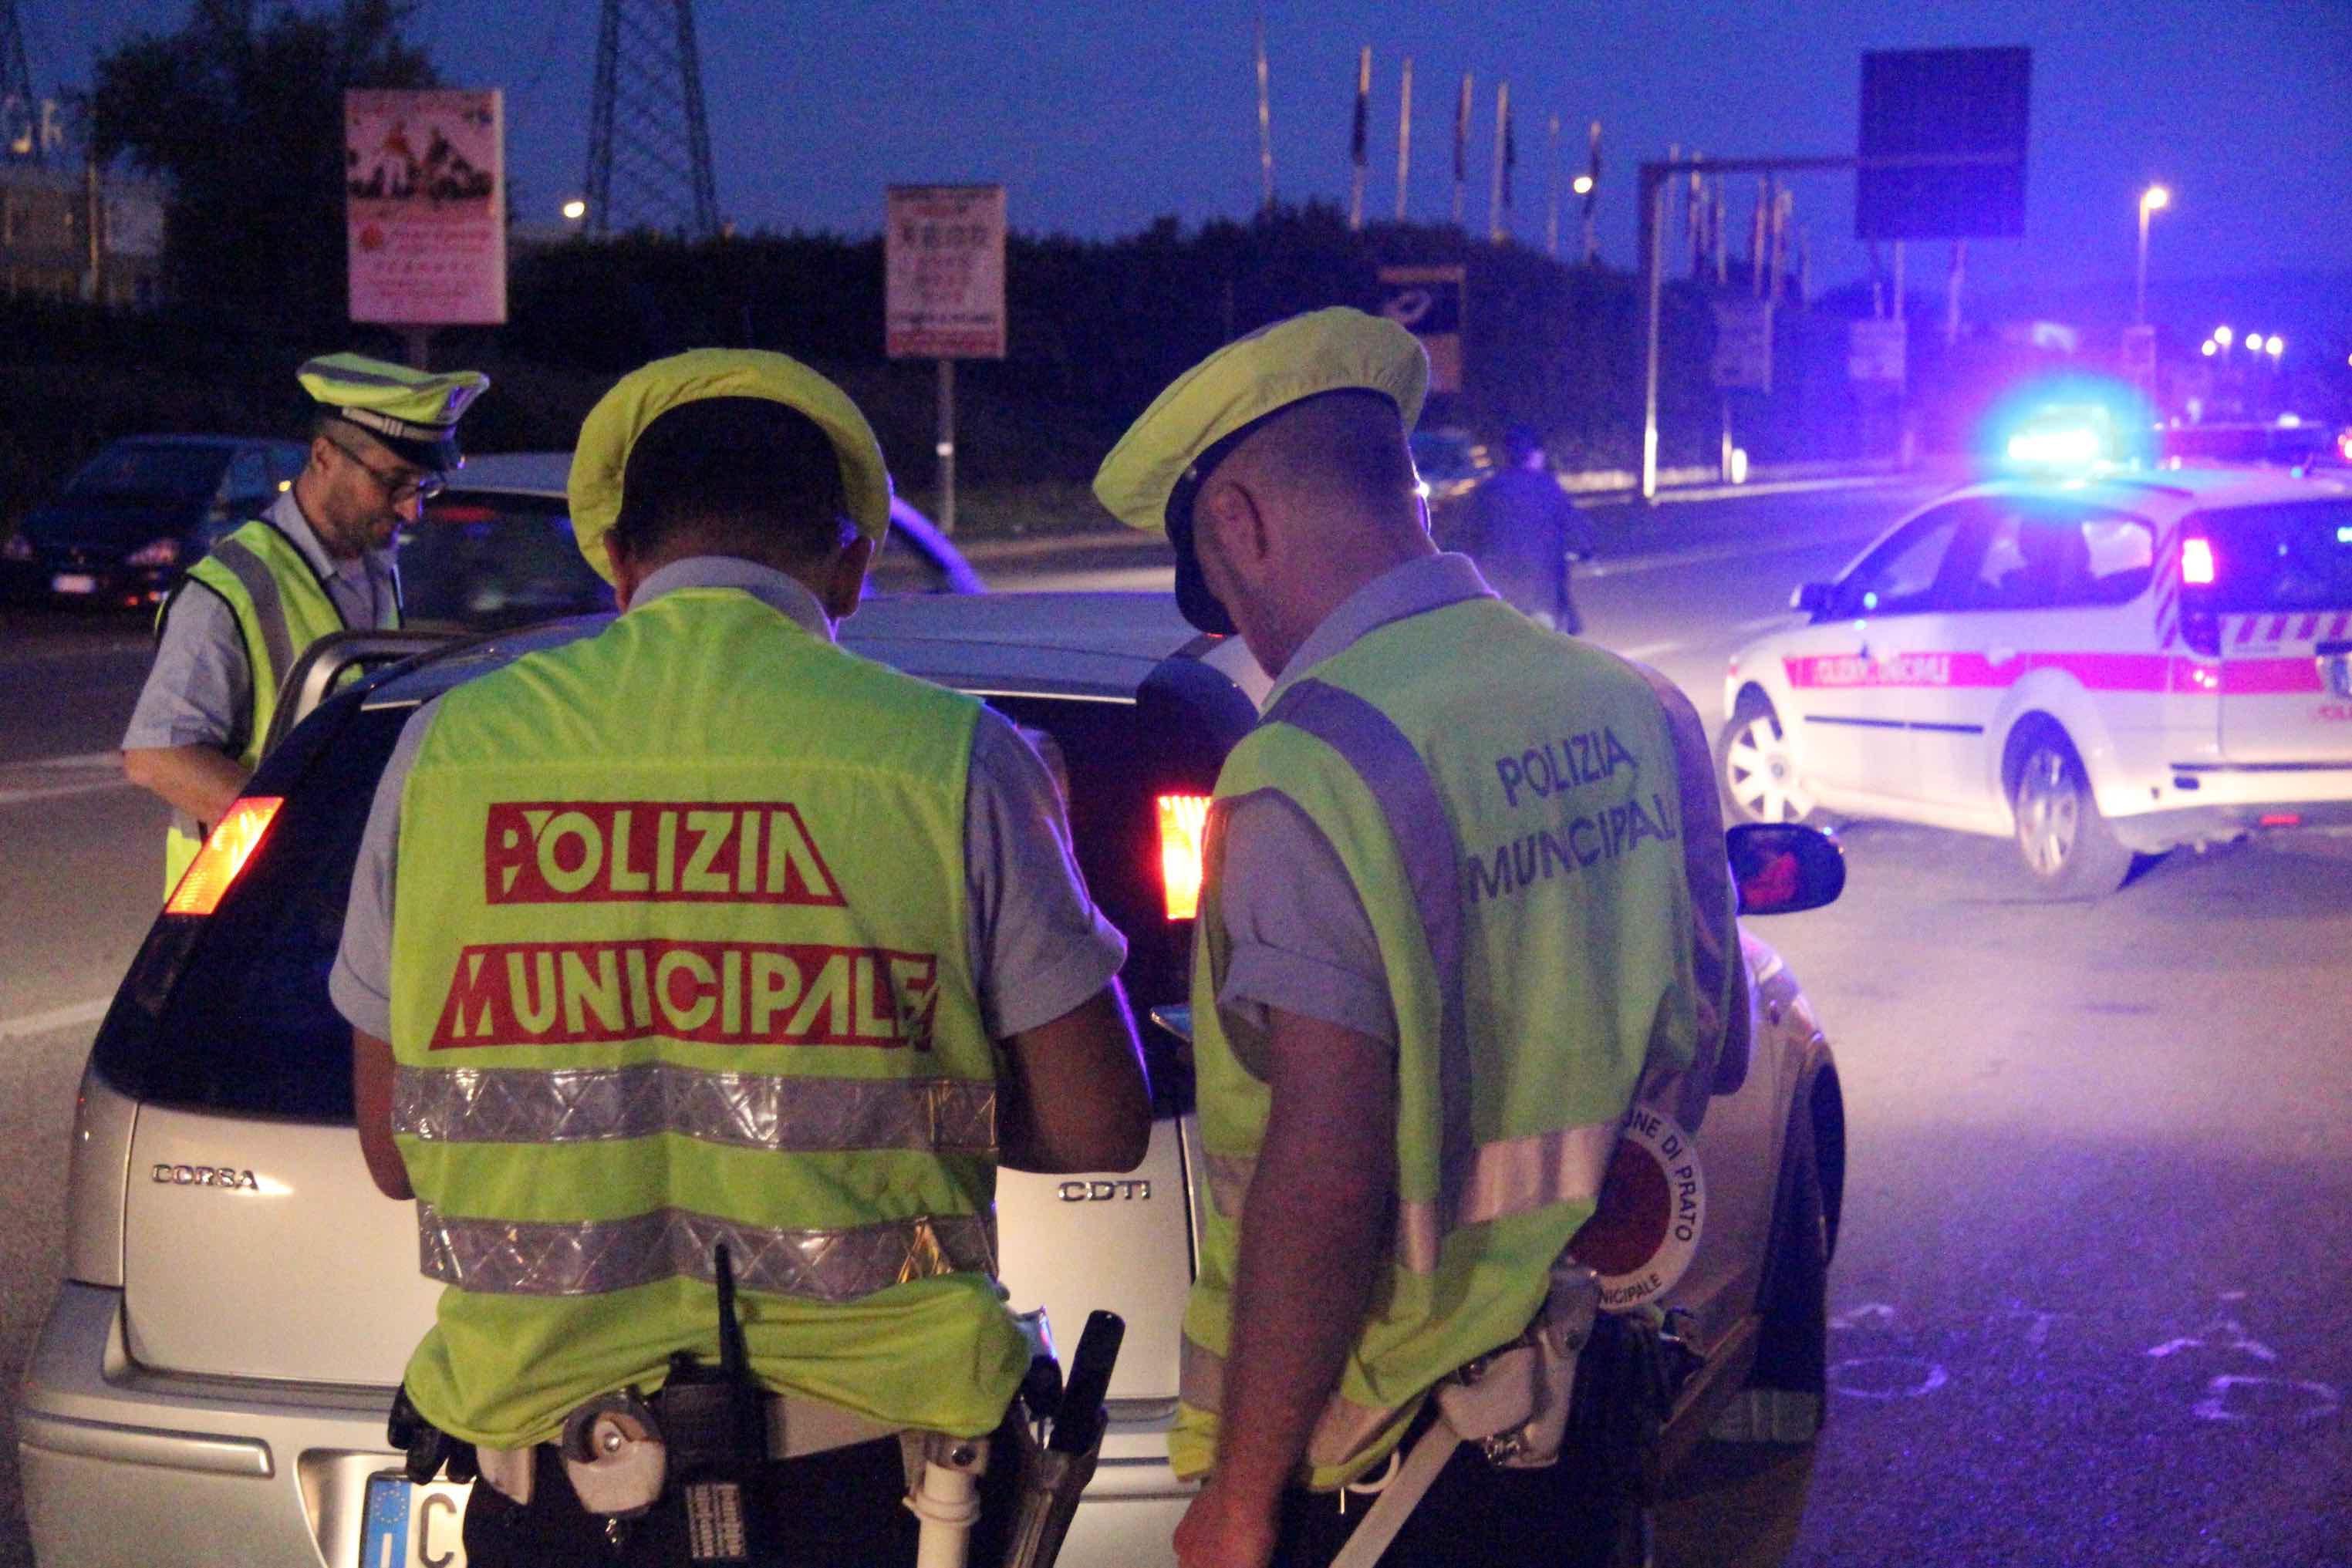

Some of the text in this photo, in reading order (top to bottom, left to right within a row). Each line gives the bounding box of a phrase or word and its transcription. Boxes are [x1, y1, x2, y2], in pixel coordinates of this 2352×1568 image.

[1496, 726, 1639, 807] POLIZIA
[494, 807, 838, 898] POLIZIA
[444, 946, 939, 1047] MUNICIPALE
[153, 1164, 259, 1190] CORSA
[1662, 1135, 1682, 1162] DI
[1675, 1165, 1696, 1241] PRATO
